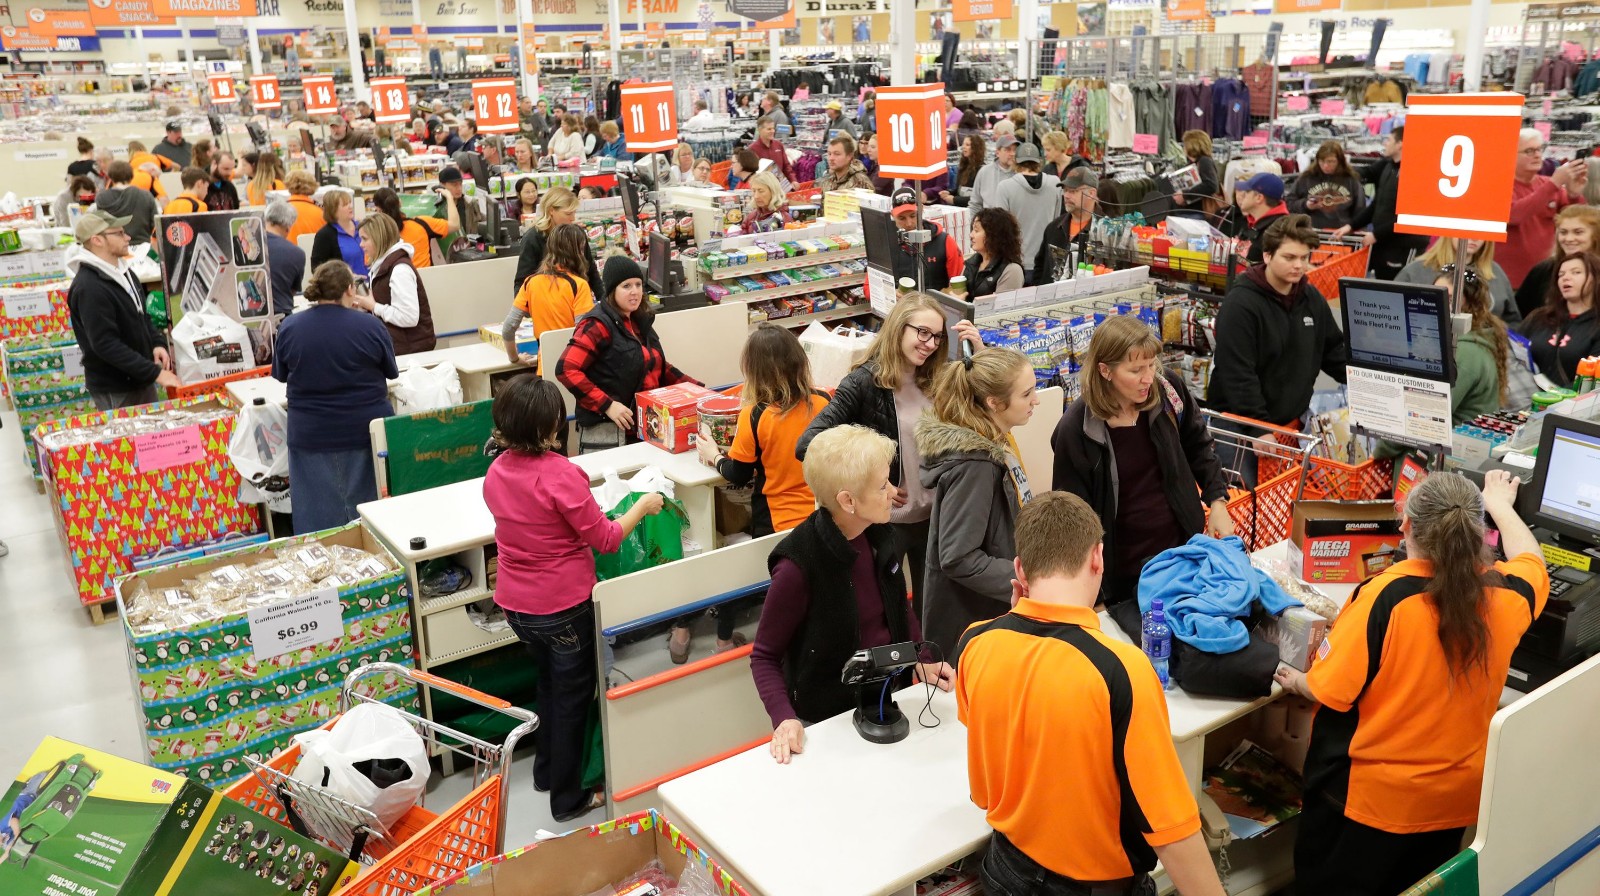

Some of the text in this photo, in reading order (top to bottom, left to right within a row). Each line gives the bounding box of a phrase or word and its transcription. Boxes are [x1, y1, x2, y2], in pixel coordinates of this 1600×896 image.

[115, 1, 148, 10] CANDY
[169, 0, 241, 11] MAGAZINES
[261, 83, 275, 100] 15
[317, 86, 331, 105] 14
[386, 89, 404, 111] 13
[477, 95, 489, 119] 12
[496, 93, 513, 118] 12
[631, 104, 645, 134] 11
[657, 102, 671, 131] 11
[888, 113, 915, 153] 10
[929, 110, 942, 150] 10
[1438, 134, 1475, 198] 9
[1358, 300, 1377, 309] Thank
[1363, 310, 1392, 321] shopping
[1368, 320, 1384, 329] Fleet
[1384, 322, 1401, 331] Farm
[1021, 338, 1050, 352] GIANTS
[205, 367, 244, 379] BUY TODAY
[1361, 371, 1373, 379] OUR
[1373, 373, 1396, 383] VALUED
[1397, 378, 1435, 390] CUSTOMERS
[159, 430, 185, 439] Advertised
[1310, 549, 1350, 557] WARMER
[1311, 540, 1351, 550] MEGA
[295, 595, 319, 605] Candie
[254, 612, 286, 624] California
[287, 605, 313, 615] Walnuts
[277, 620, 318, 641] $6.99
[176, 802, 188, 816] 3+
[47, 873, 99, 896] pour tracteur
